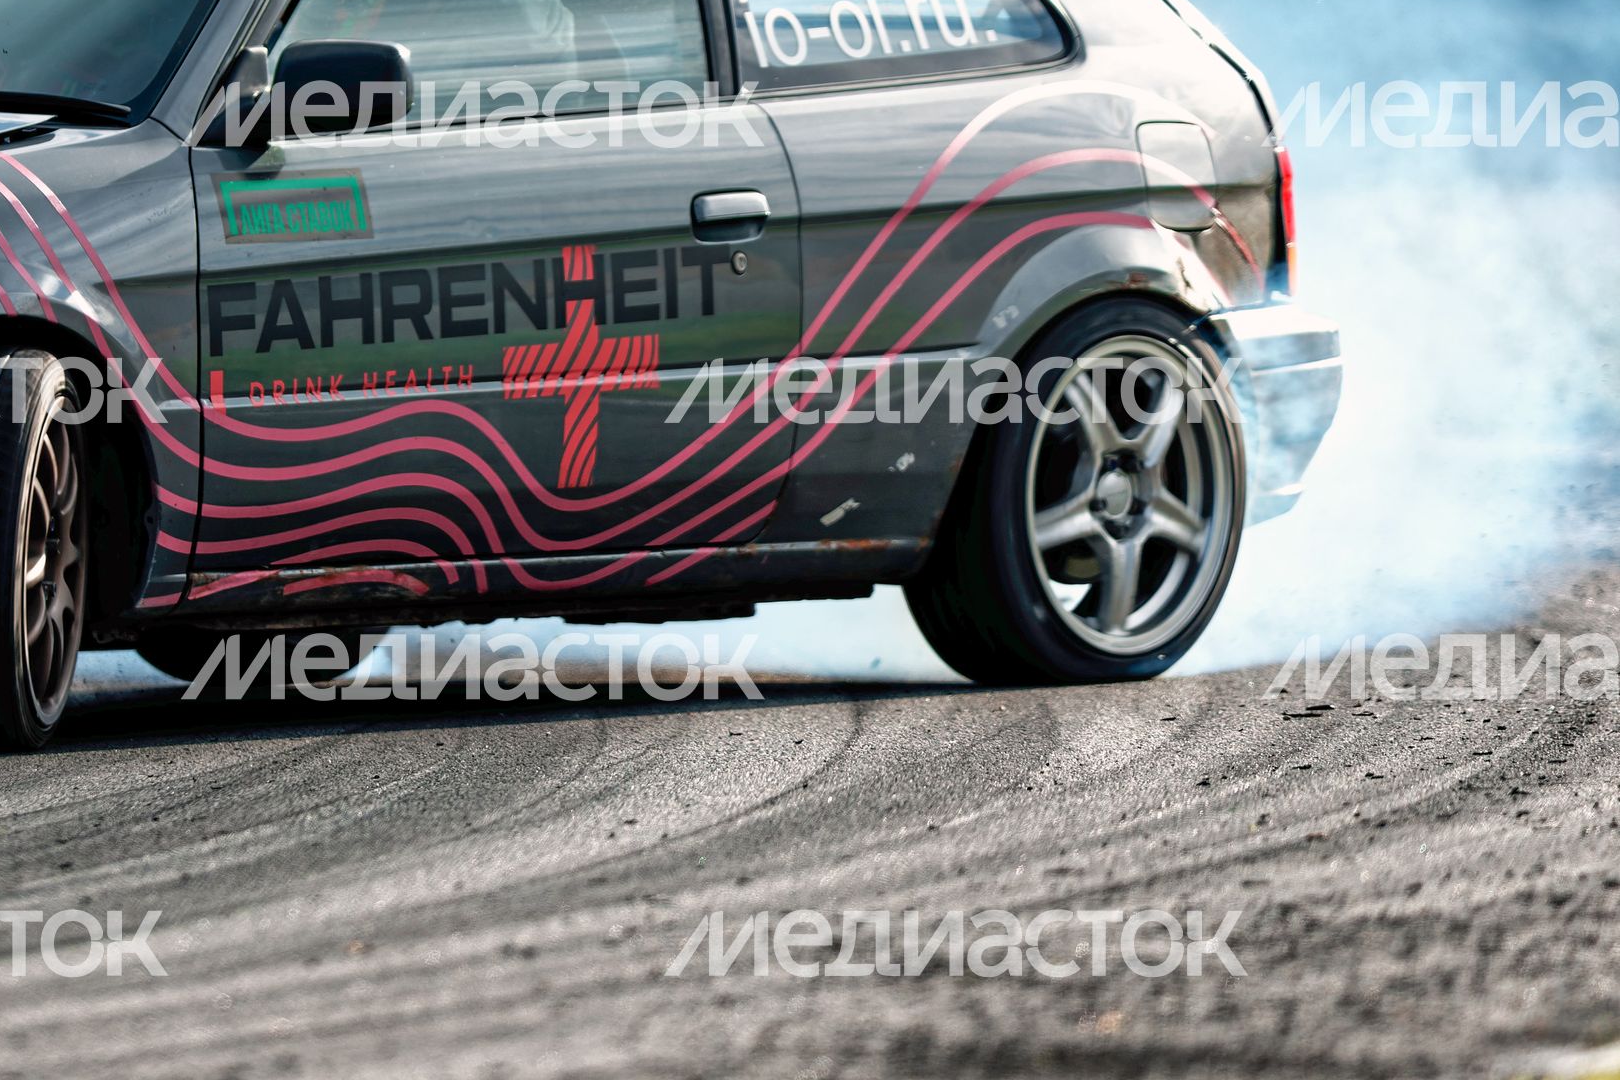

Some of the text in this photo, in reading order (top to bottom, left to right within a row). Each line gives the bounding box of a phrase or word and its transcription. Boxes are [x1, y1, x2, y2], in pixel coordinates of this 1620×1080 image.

[240, 200, 356, 236] ЛИГА СТАВОК
[206, 243, 731, 357] FAHRENHEIT
[249, 364, 474, 408] DRINK HEALTH
